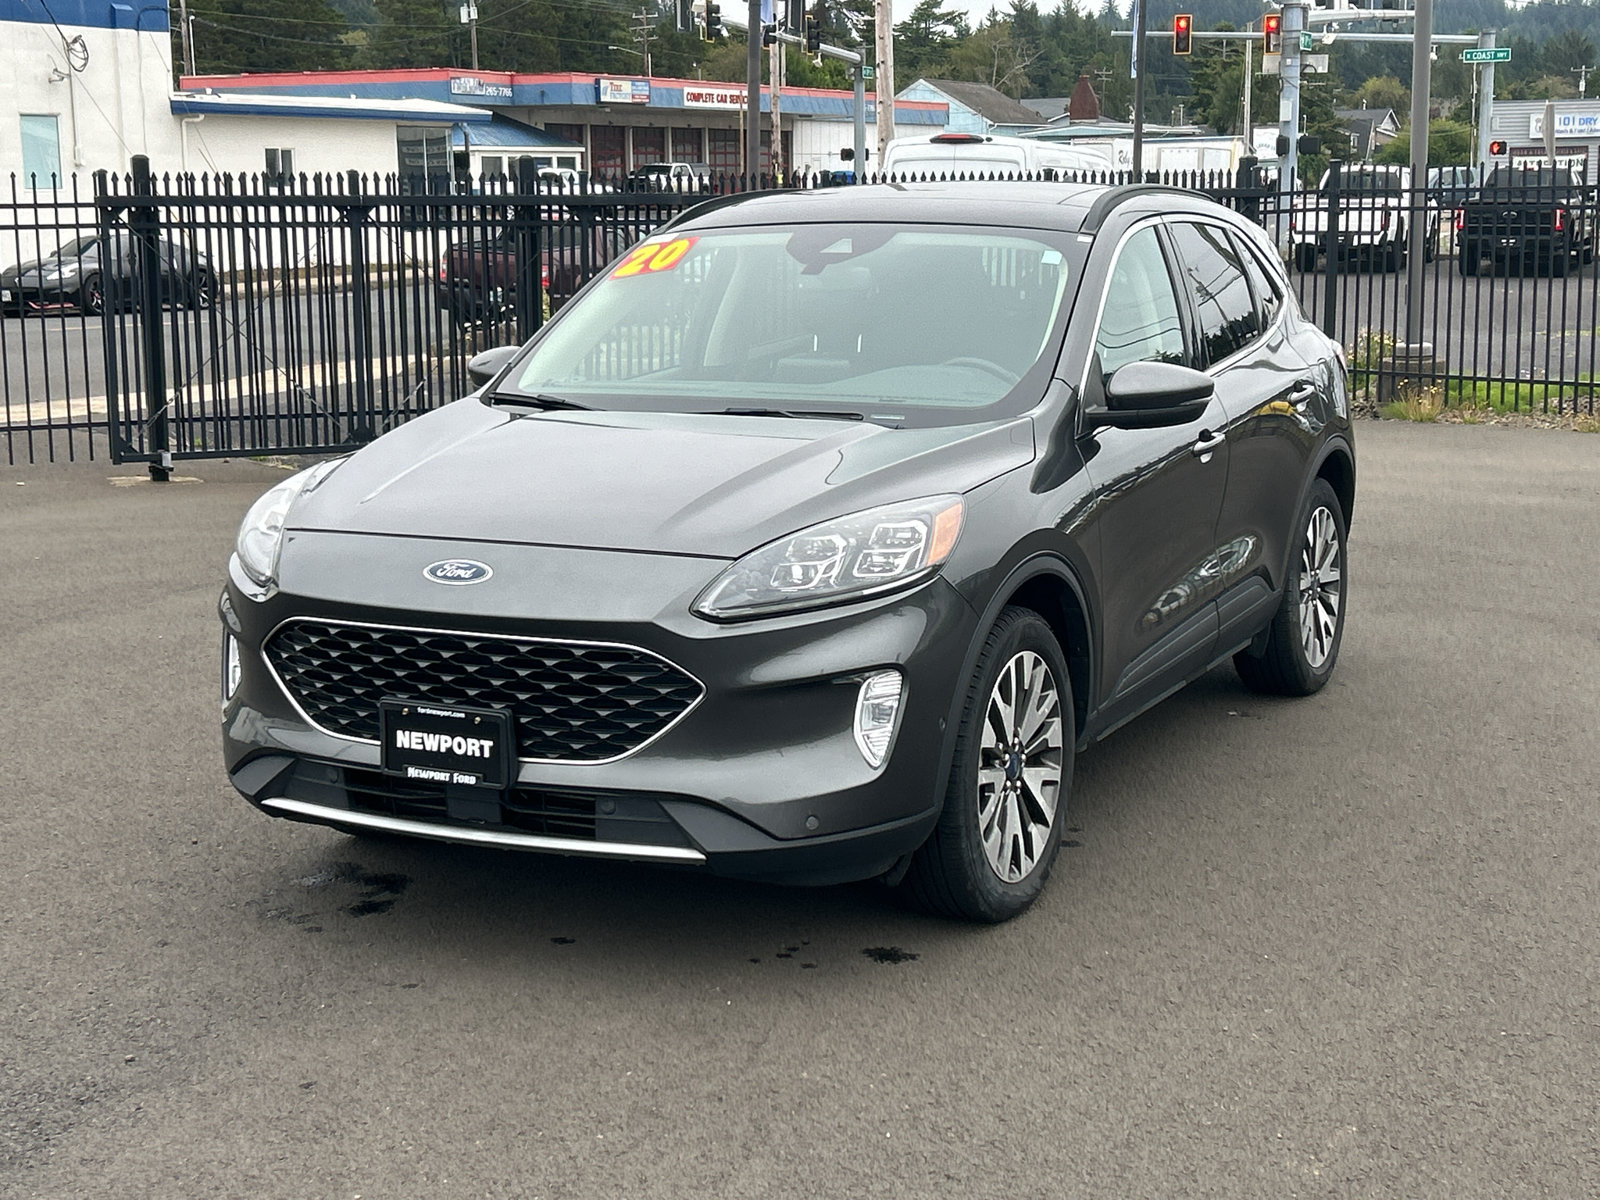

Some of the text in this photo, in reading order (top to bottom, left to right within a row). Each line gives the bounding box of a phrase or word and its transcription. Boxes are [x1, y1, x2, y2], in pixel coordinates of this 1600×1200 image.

[1472, 51, 1495, 60] COAST
[686, 91, 748, 105] COMPLETE CAR SERVC
[1558, 116, 1598, 126] 101 DRY
[613, 239, 690, 277] 20
[436, 561, 476, 579] Ford
[396, 729, 494, 758] NEWPORT
